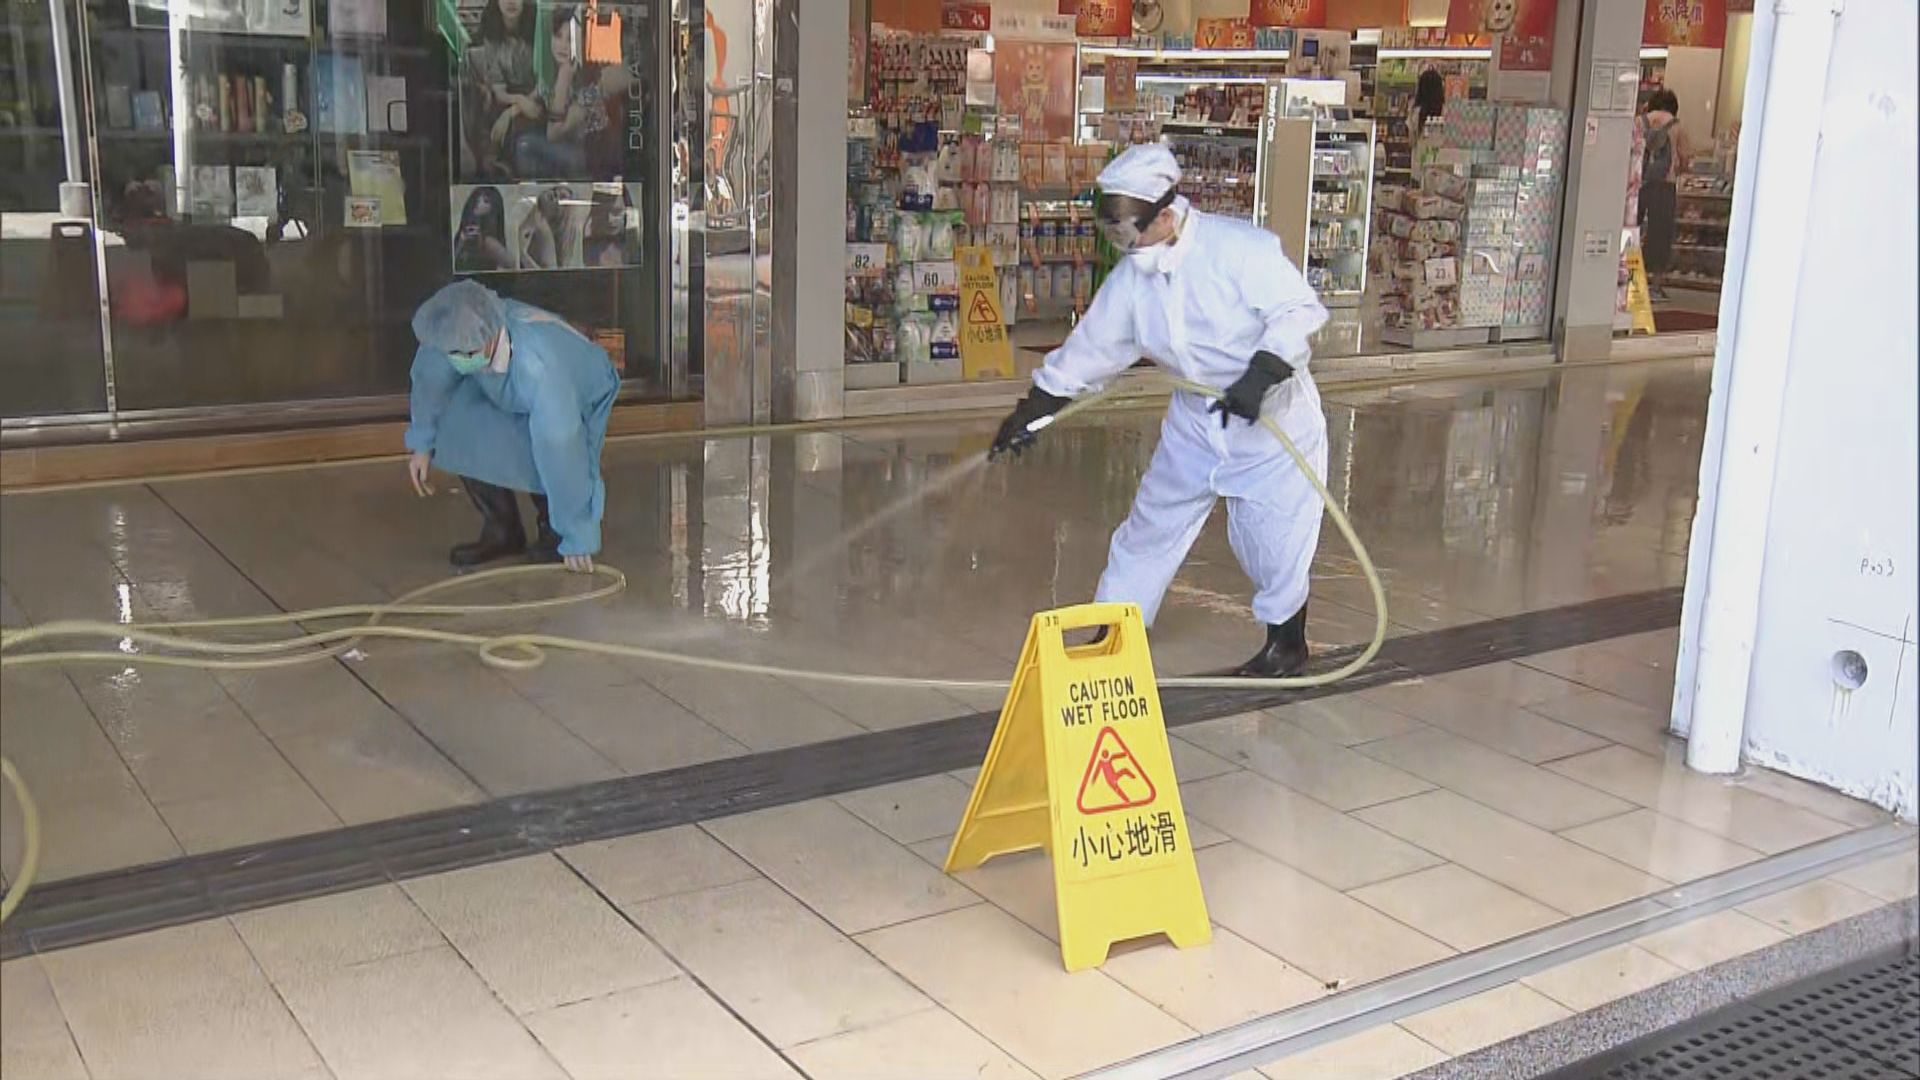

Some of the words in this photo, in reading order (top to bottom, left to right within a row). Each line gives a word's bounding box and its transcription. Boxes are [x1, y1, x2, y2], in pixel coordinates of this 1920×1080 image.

[1069, 675, 1135, 703] CAUTION
[1061, 704, 1093, 727] WET
[1102, 697, 1149, 721] FLOOR
[1072, 811, 1177, 867] 小心地滑
